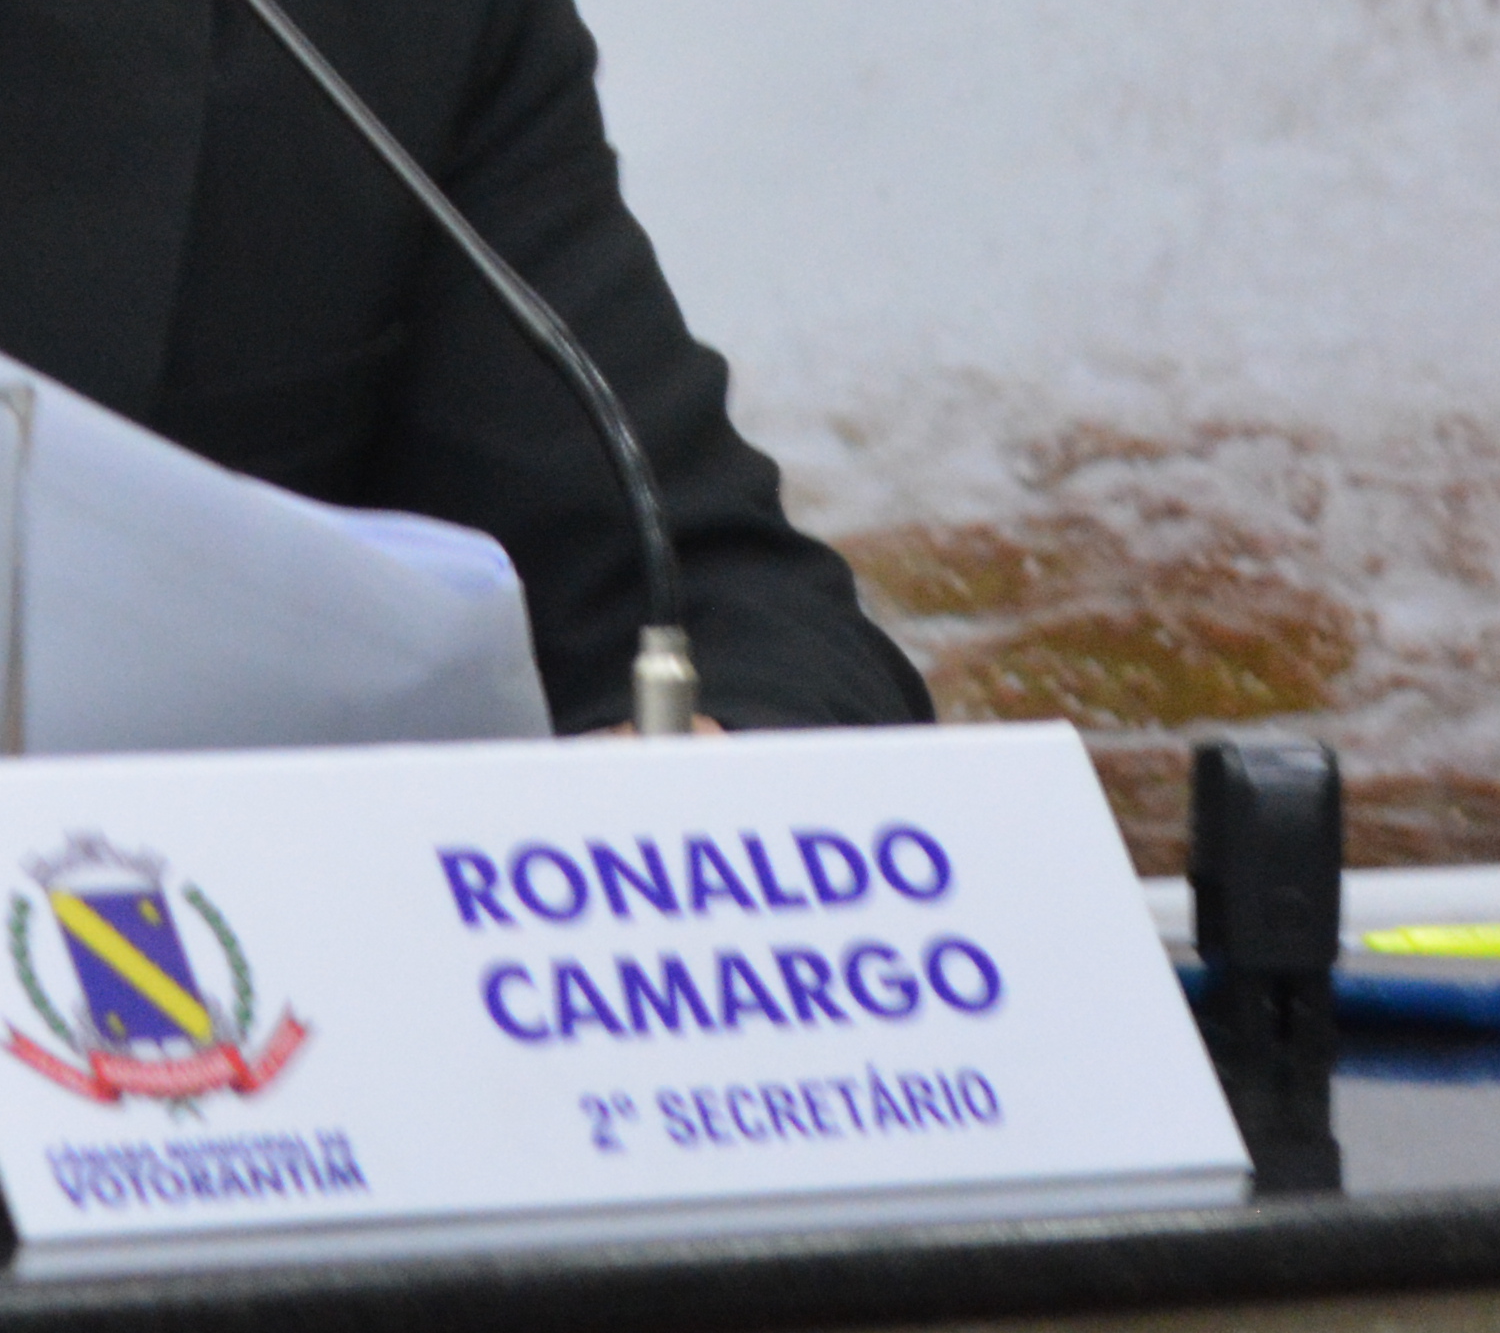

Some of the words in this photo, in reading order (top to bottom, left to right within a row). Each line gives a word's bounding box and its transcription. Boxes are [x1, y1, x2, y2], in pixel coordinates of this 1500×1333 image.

[434, 819, 954, 929] RONALDO
[480, 931, 1003, 1045] CAMARGO
[655, 1061, 1004, 1150] SECRETÁRIO
[52, 1153, 369, 1209] VOTORANTIM
